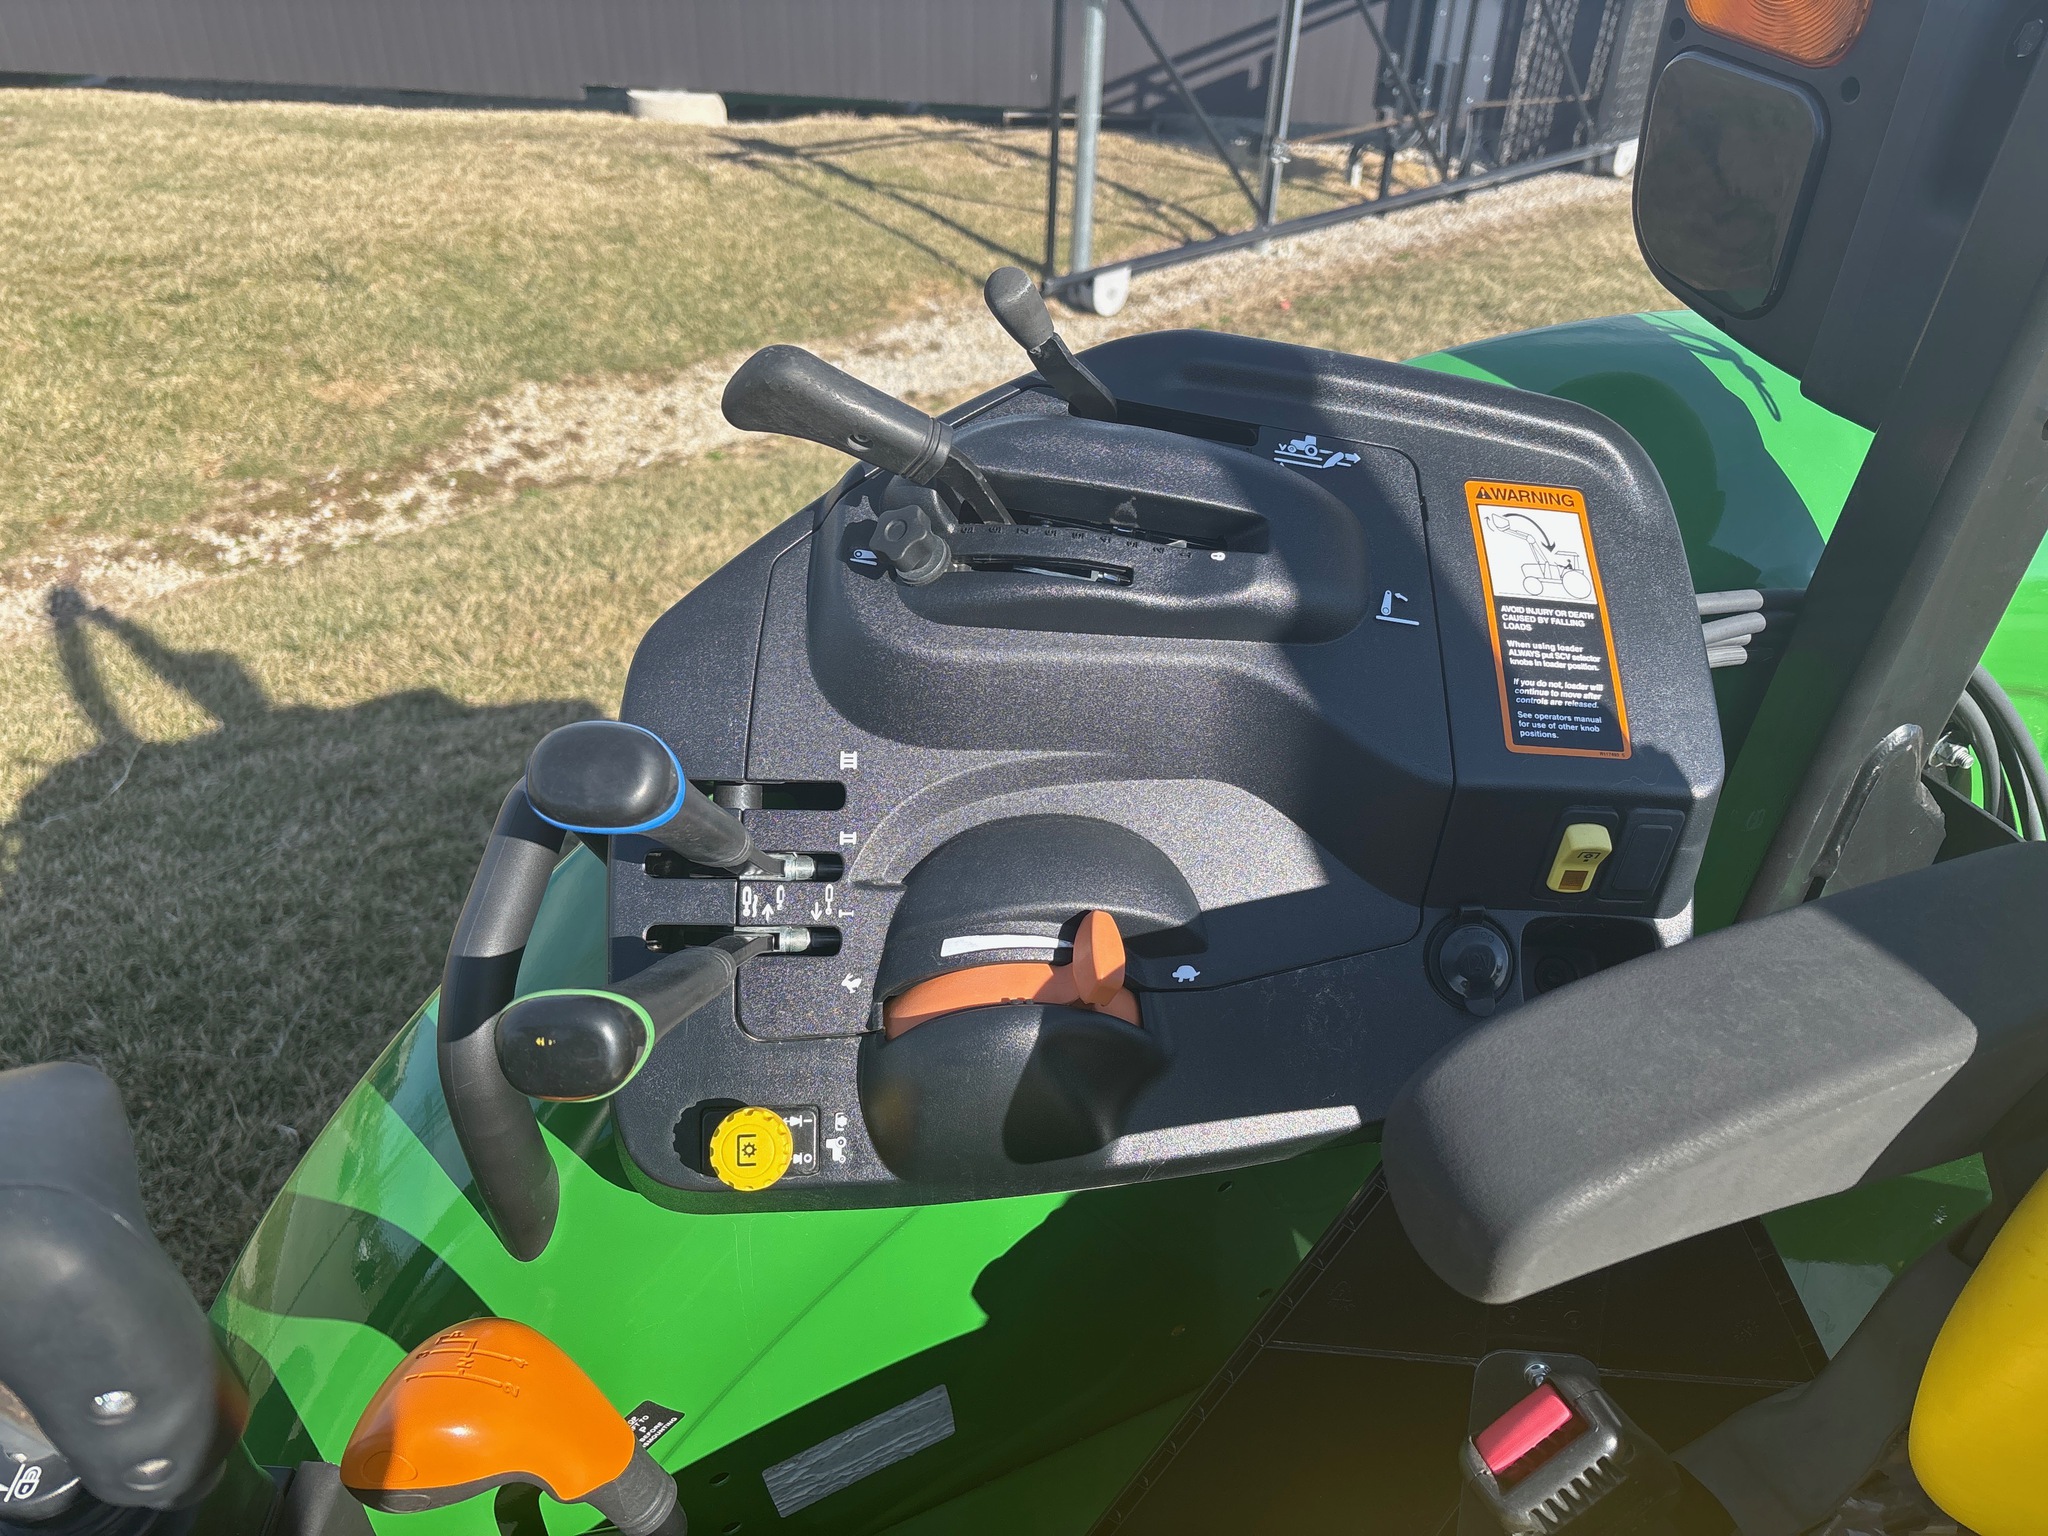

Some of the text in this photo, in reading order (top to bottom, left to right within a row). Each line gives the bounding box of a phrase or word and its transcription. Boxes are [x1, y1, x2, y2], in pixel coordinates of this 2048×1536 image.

[1490, 487, 1575, 507] WARNING
[1501, 605, 1595, 620] AVOID INJURY OR DEATH
[1501, 613, 1586, 628] CAUSED BY FALLING
[1503, 622, 1533, 631] LOADS
[1506, 639, 1584, 653] When using loader
[1508, 649, 1601, 663] ALWAYS put SCV selector
[1509, 657, 1600, 672] knobs in loader position.
[1513, 677, 1604, 692] If you do not, loader will
[1514, 688, 1603, 701] continue to move after
[1515, 697, 1549, 705] controls
[1564, 699, 1600, 709] released.
[1517, 710, 1602, 724] See operators manual
[1518, 720, 1530, 728] for
[1547, 722, 1557, 730] of
[1557, 723, 1579, 732] other
[1580, 724, 1601, 733] knob
[1519, 730, 1560, 739] positions.
[502, 1382, 520, 1398] 2
[638, 1415, 649, 1423] TO
